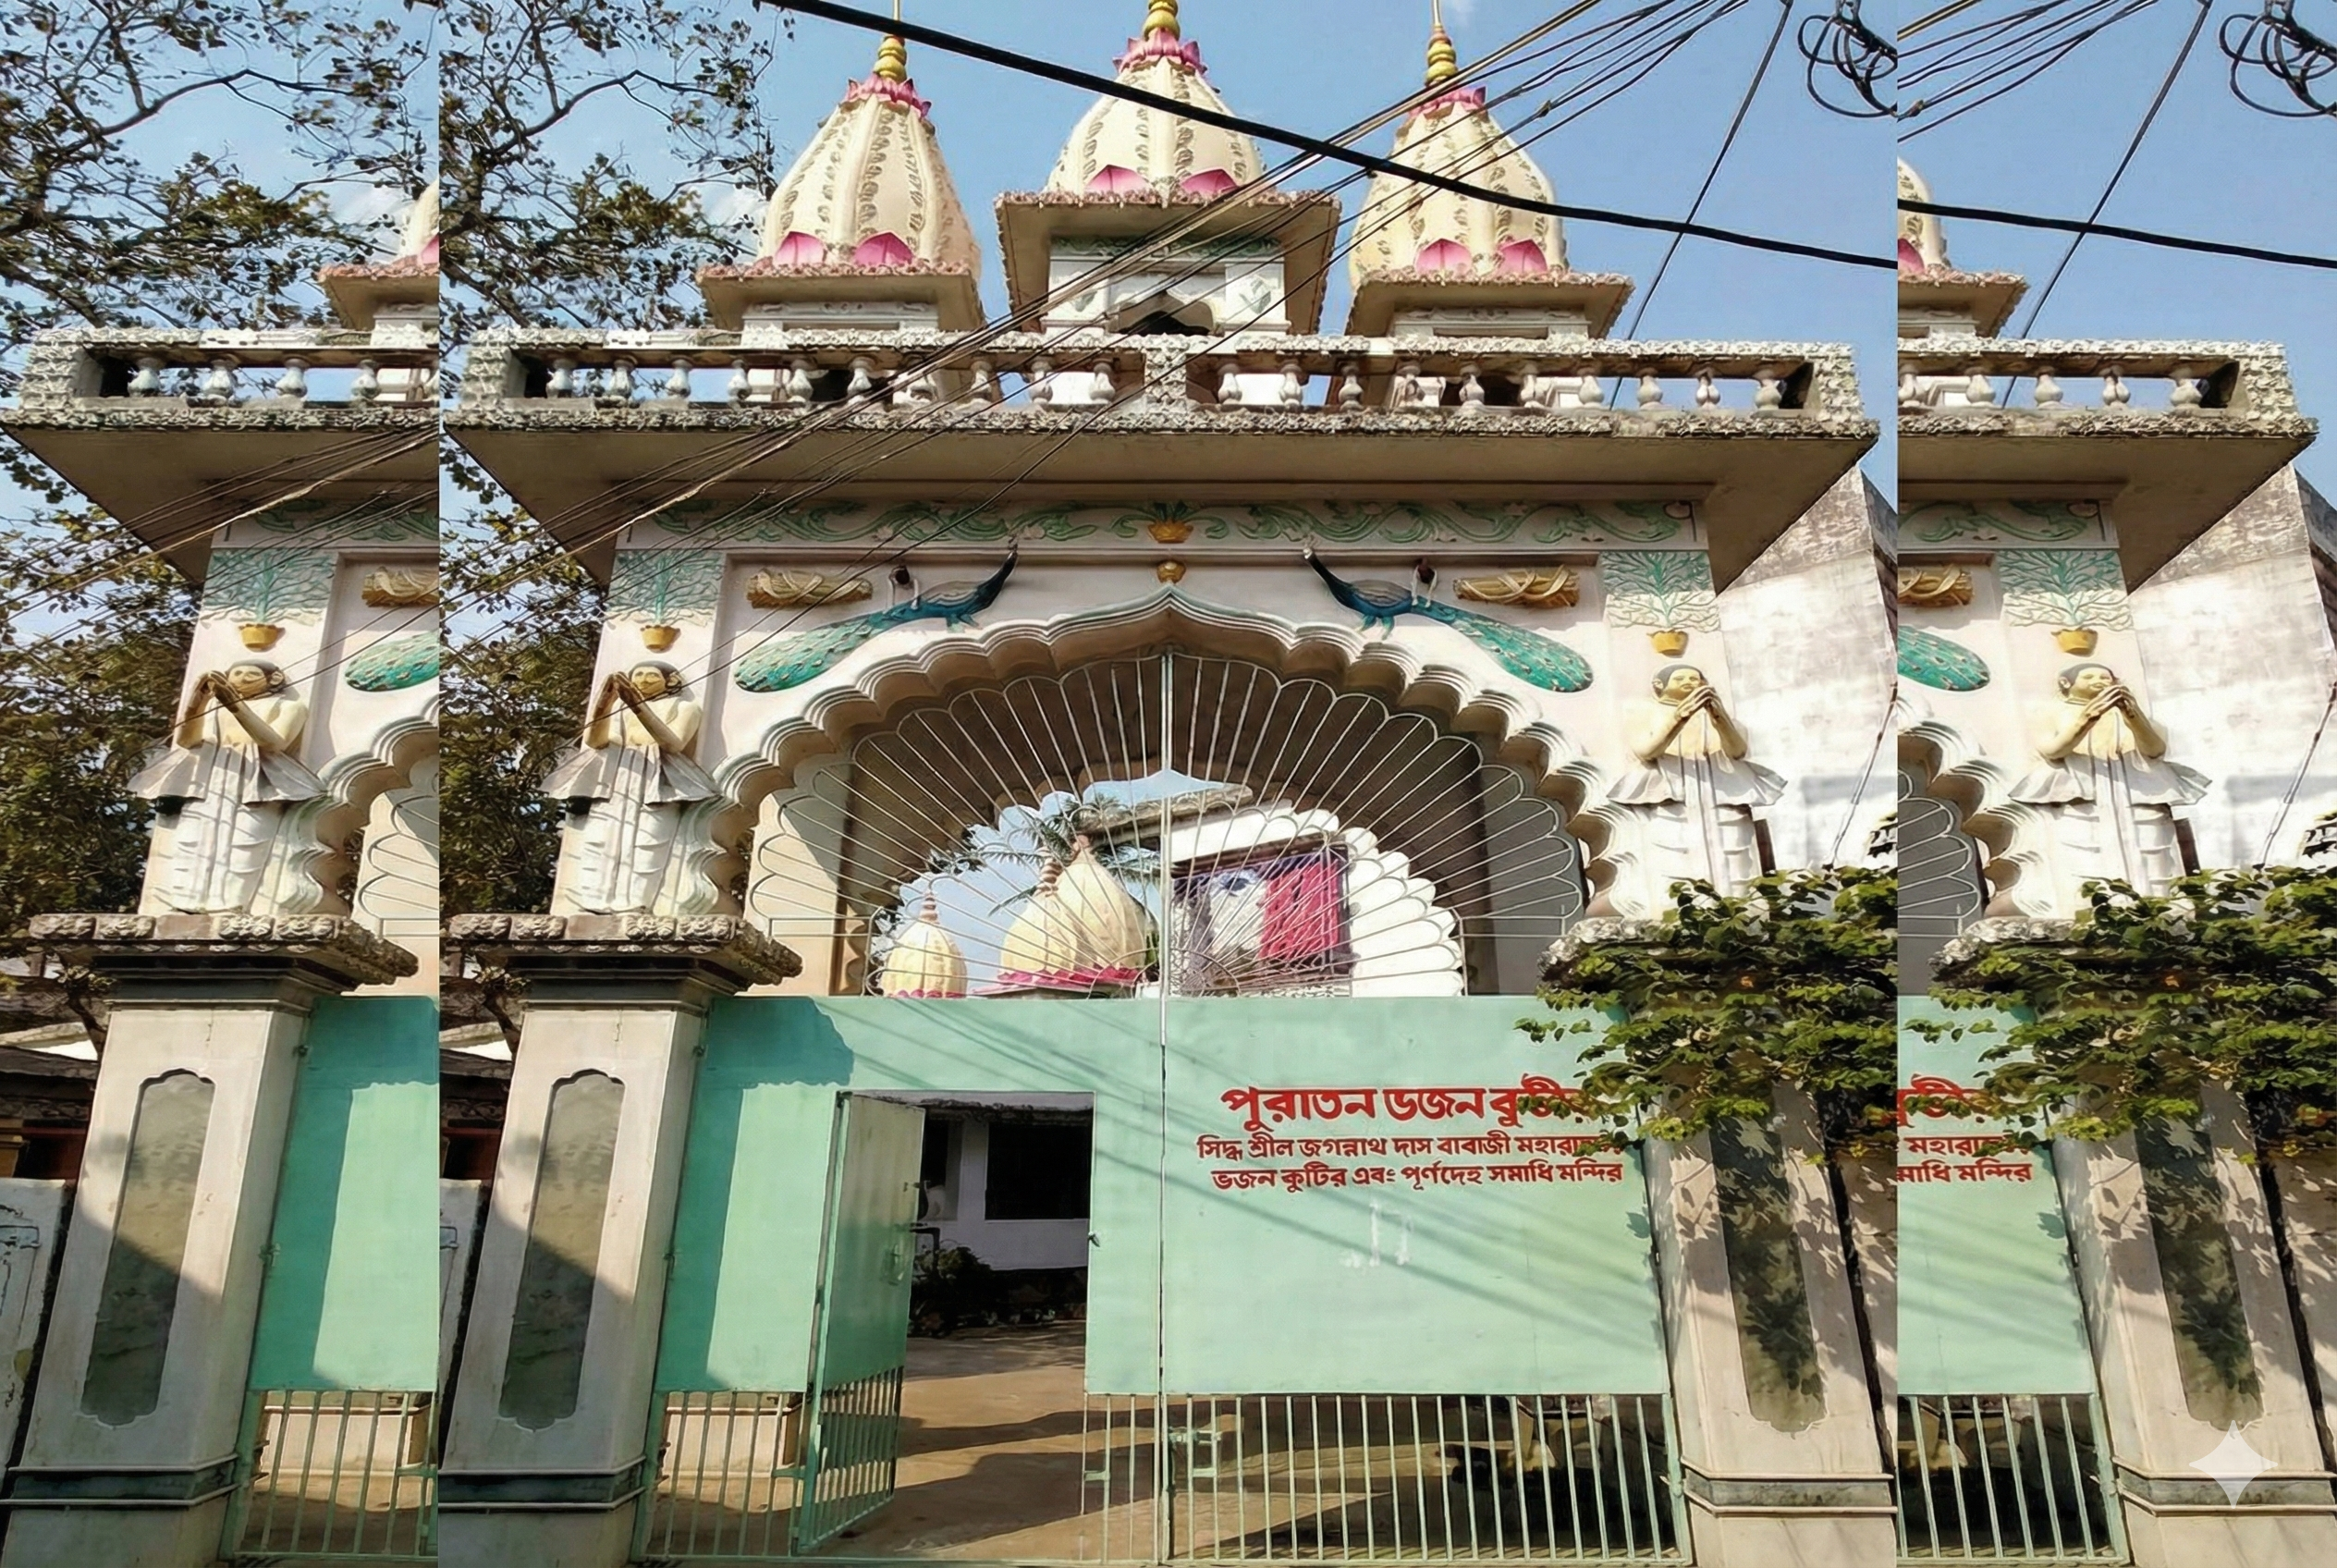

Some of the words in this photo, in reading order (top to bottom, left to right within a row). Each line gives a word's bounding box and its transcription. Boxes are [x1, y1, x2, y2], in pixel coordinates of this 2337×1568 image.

[1221, 1086, 1377, 1132] পুরাতন
[1197, 1134, 1242, 1161] সিদ্ধ
[1248, 1132, 1294, 1158] শ্রীল
[1298, 1137, 1387, 1158] জগন্নাথ
[1391, 1137, 1433, 1158] দাস
[1438, 1130, 1511, 1156] বাবাজী
[1211, 1170, 1278, 1189] ভজন
[1280, 1161, 1348, 1193] কুটির
[1352, 1167, 1396, 1185] এবং
[1401, 1160, 1484, 1190] পূর্ণদেহ
[1486, 1158, 1554, 1182] সমাধি
[1556, 1157, 1623, 1182] মন্দির
[1897, 1158, 1952, 1182] মাধি
[1953, 1157, 2032, 1182] মন্দির
